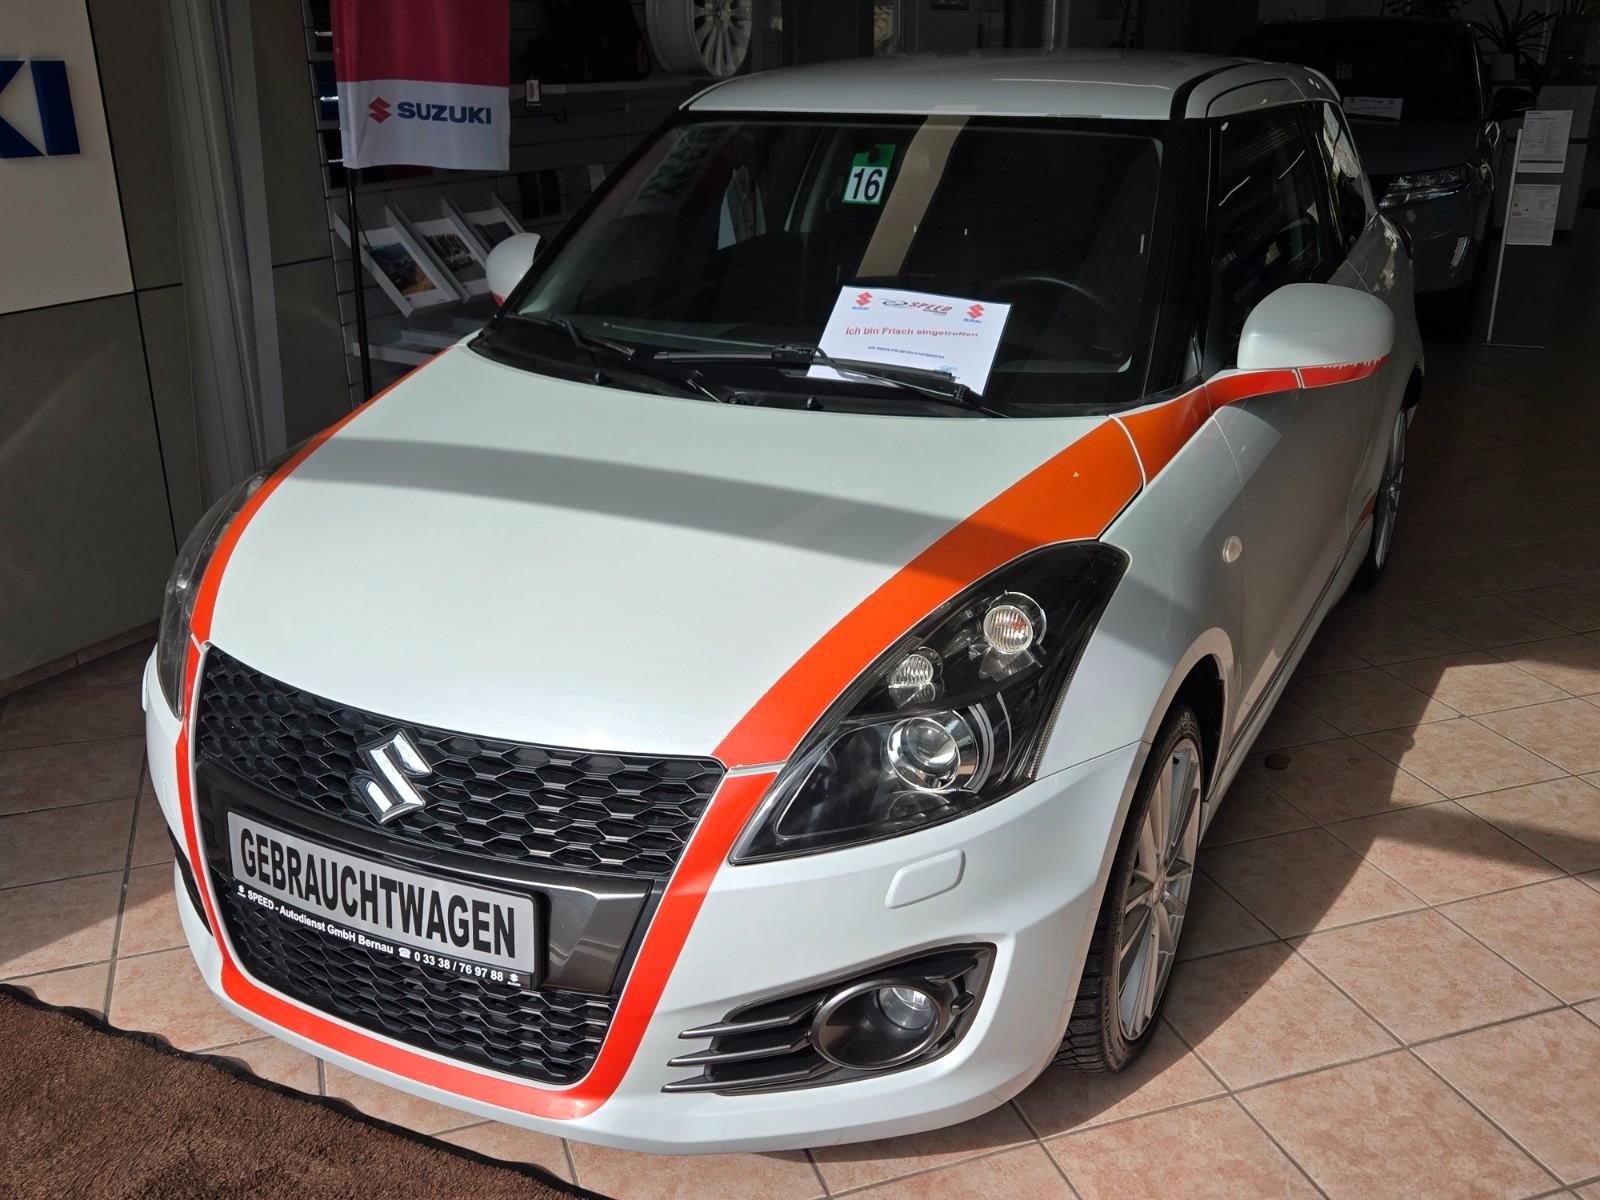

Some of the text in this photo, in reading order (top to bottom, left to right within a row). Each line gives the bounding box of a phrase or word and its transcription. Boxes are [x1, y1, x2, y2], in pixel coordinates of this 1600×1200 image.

[397, 101, 492, 125] SUZUKI
[853, 168, 883, 201] 16
[908, 302, 953, 312] SPEED
[863, 326, 880, 335] bin
[882, 327, 914, 336] Frisch
[240, 827, 516, 959] GEBRAUCHTWAGEN
[247, 889, 275, 911] SPEED
[279, 904, 326, 932] Autodienst
[327, 923, 356, 943] GmbH
[358, 935, 394, 955] Bernau
[414, 952, 421, 963] 0
[423, 953, 436, 966] 33
[438, 957, 451, 971] 38
[459, 962, 473, 976] 76
[474, 966, 488, 979] 97
[490, 969, 504, 982] 88
